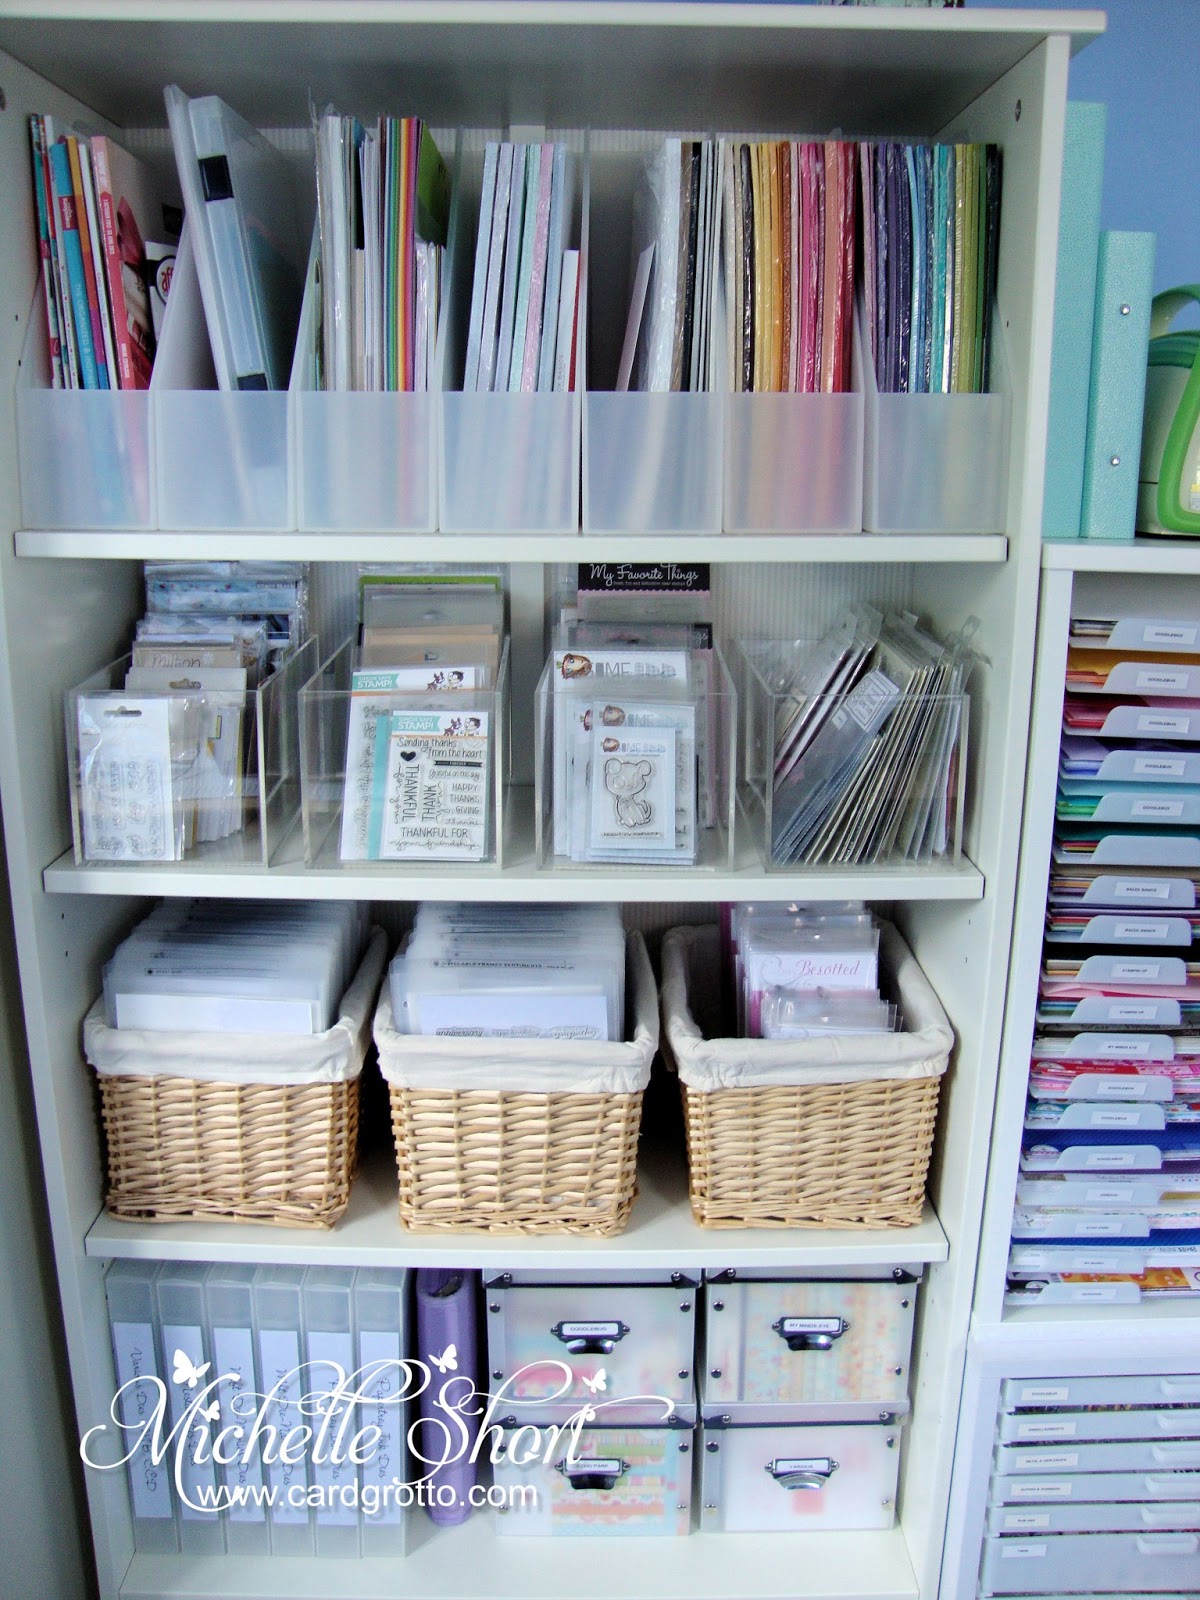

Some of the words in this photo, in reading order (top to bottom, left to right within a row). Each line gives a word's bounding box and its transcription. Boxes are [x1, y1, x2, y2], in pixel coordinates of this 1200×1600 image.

[77, 300, 89, 345] ORGANIZED
[589, 563, 615, 586] My
[616, 564, 664, 580] Favorite
[660, 563, 699, 587] Things
[151, 650, 201, 668] Milton
[357, 679, 393, 689] STAMP!
[358, 675, 377, 683] SIMON
[397, 721, 435, 730] STAMP!
[397, 737, 430, 756] Sending
[431, 739, 457, 748] thanks
[427, 747, 448, 759] from
[448, 748, 461, 758] the
[462, 748, 483, 759] heart
[401, 763, 420, 822] THANKFUL
[452, 783, 478, 792] HAPPY
[421, 784, 438, 822] THANK
[449, 794, 480, 803] THANKS
[455, 806, 480, 815] GIVING
[400, 827, 450, 838] THANKFUL
[451, 828, 469, 839] FOR
[795, 959, 862, 976] Besotted
[135, 1392, 148, 1416] Dies
[370, 1378, 392, 1429] Papertrey
[378, 1432, 391, 1451] Ink
[237, 1460, 249, 1484] Dies
[281, 1463, 294, 1486] Dies
[378, 1454, 391, 1479] Dies
